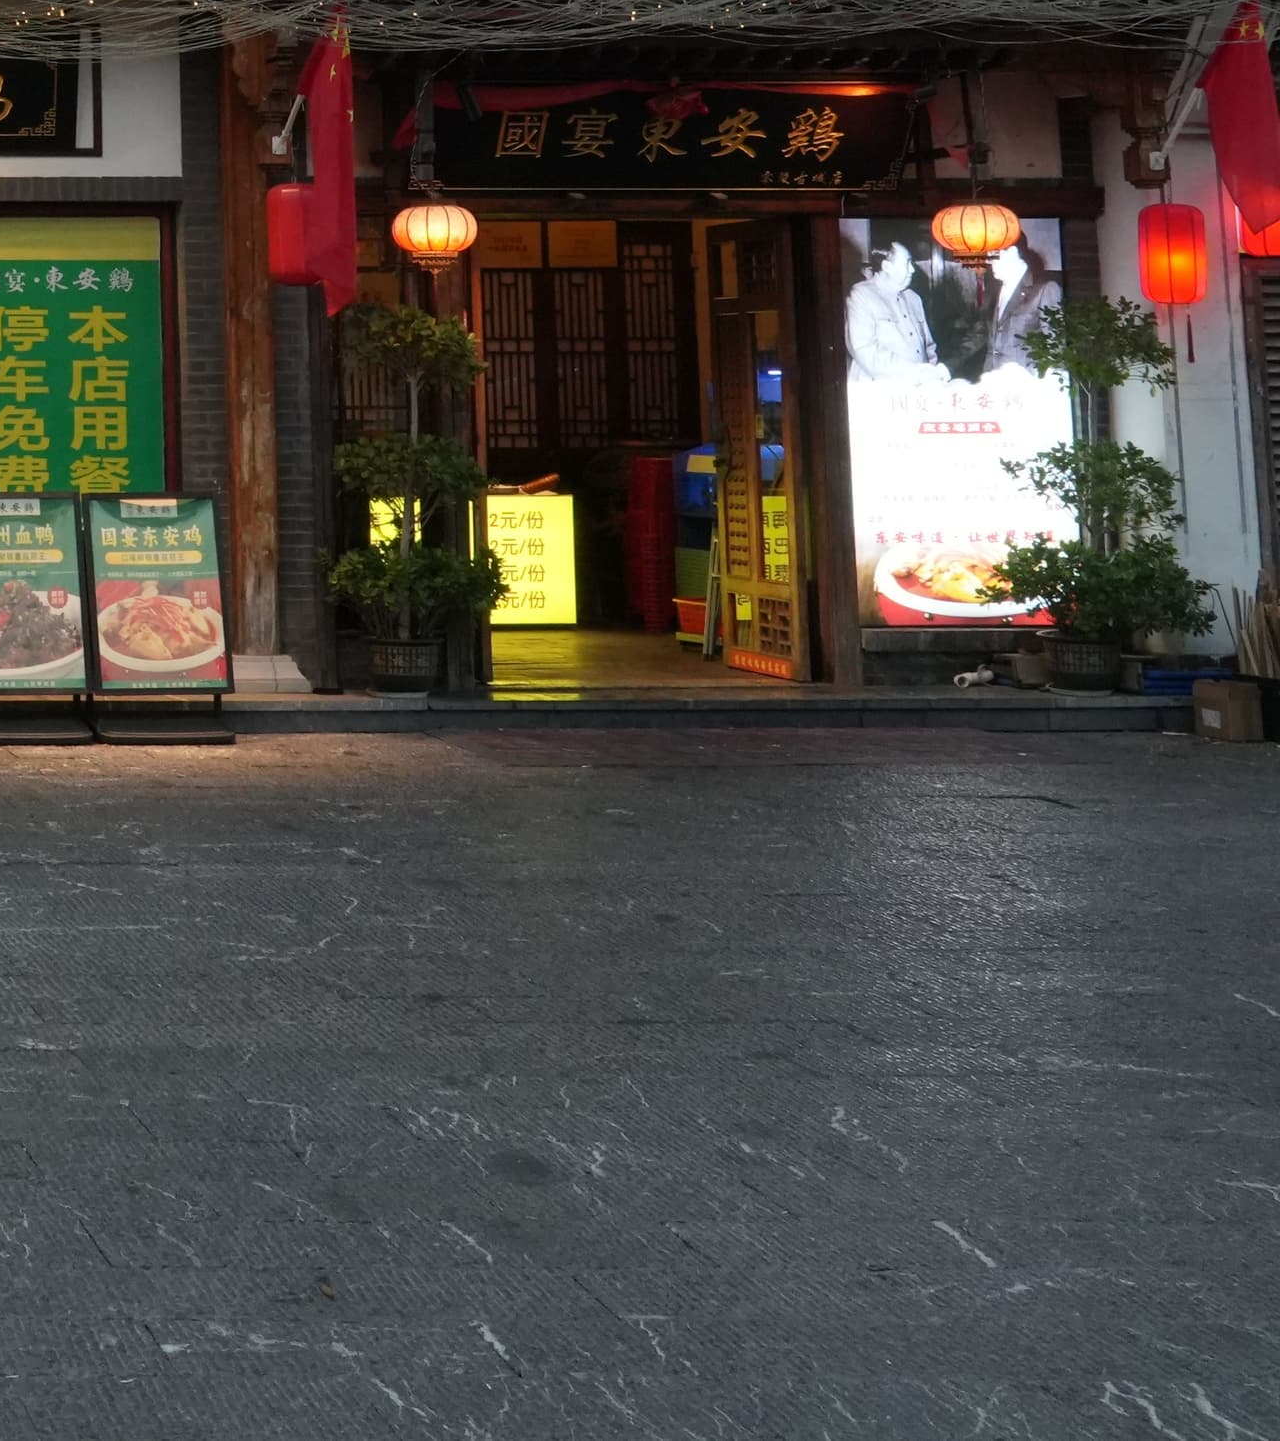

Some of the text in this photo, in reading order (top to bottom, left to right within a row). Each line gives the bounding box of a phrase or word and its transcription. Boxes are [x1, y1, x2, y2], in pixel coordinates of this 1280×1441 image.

[67, 305, 131, 495] 本店用餐
[489, 511, 544, 529] 2元/份
[100, 525, 203, 548] 国宴东安鸡
[501, 564, 546, 582] 元/份
[500, 590, 546, 609] 元/份
